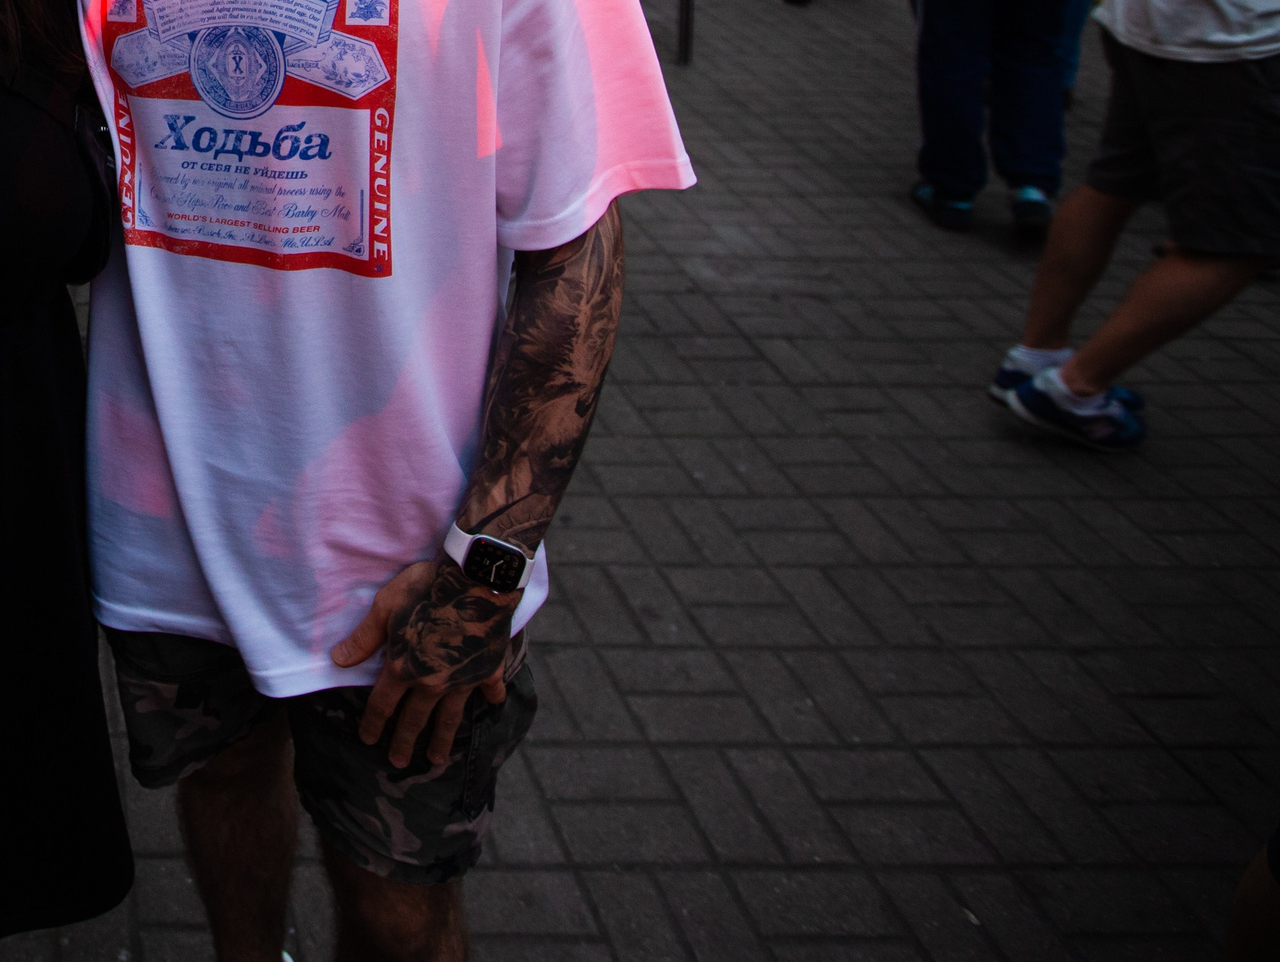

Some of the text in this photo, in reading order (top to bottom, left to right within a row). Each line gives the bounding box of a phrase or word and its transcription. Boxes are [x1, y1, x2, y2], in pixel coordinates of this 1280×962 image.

[288, 23, 300, 32] any
[308, 13, 321, 22] Our
[153, 113, 333, 163] Ходьба
[181, 160, 308, 180] ОТ СЕБЯ НЕ УЙДЕШЬ
[273, 187, 308, 201] process
[309, 184, 333, 201] using
[334, 185, 347, 198] the
[373, 107, 391, 261] GENUINE
[233, 200, 251, 213] and
[277, 202, 319, 223] Barley
[320, 203, 352, 222] Malt
[166, 211, 321, 234] WORLD'S LARGEST SELLING BEER
